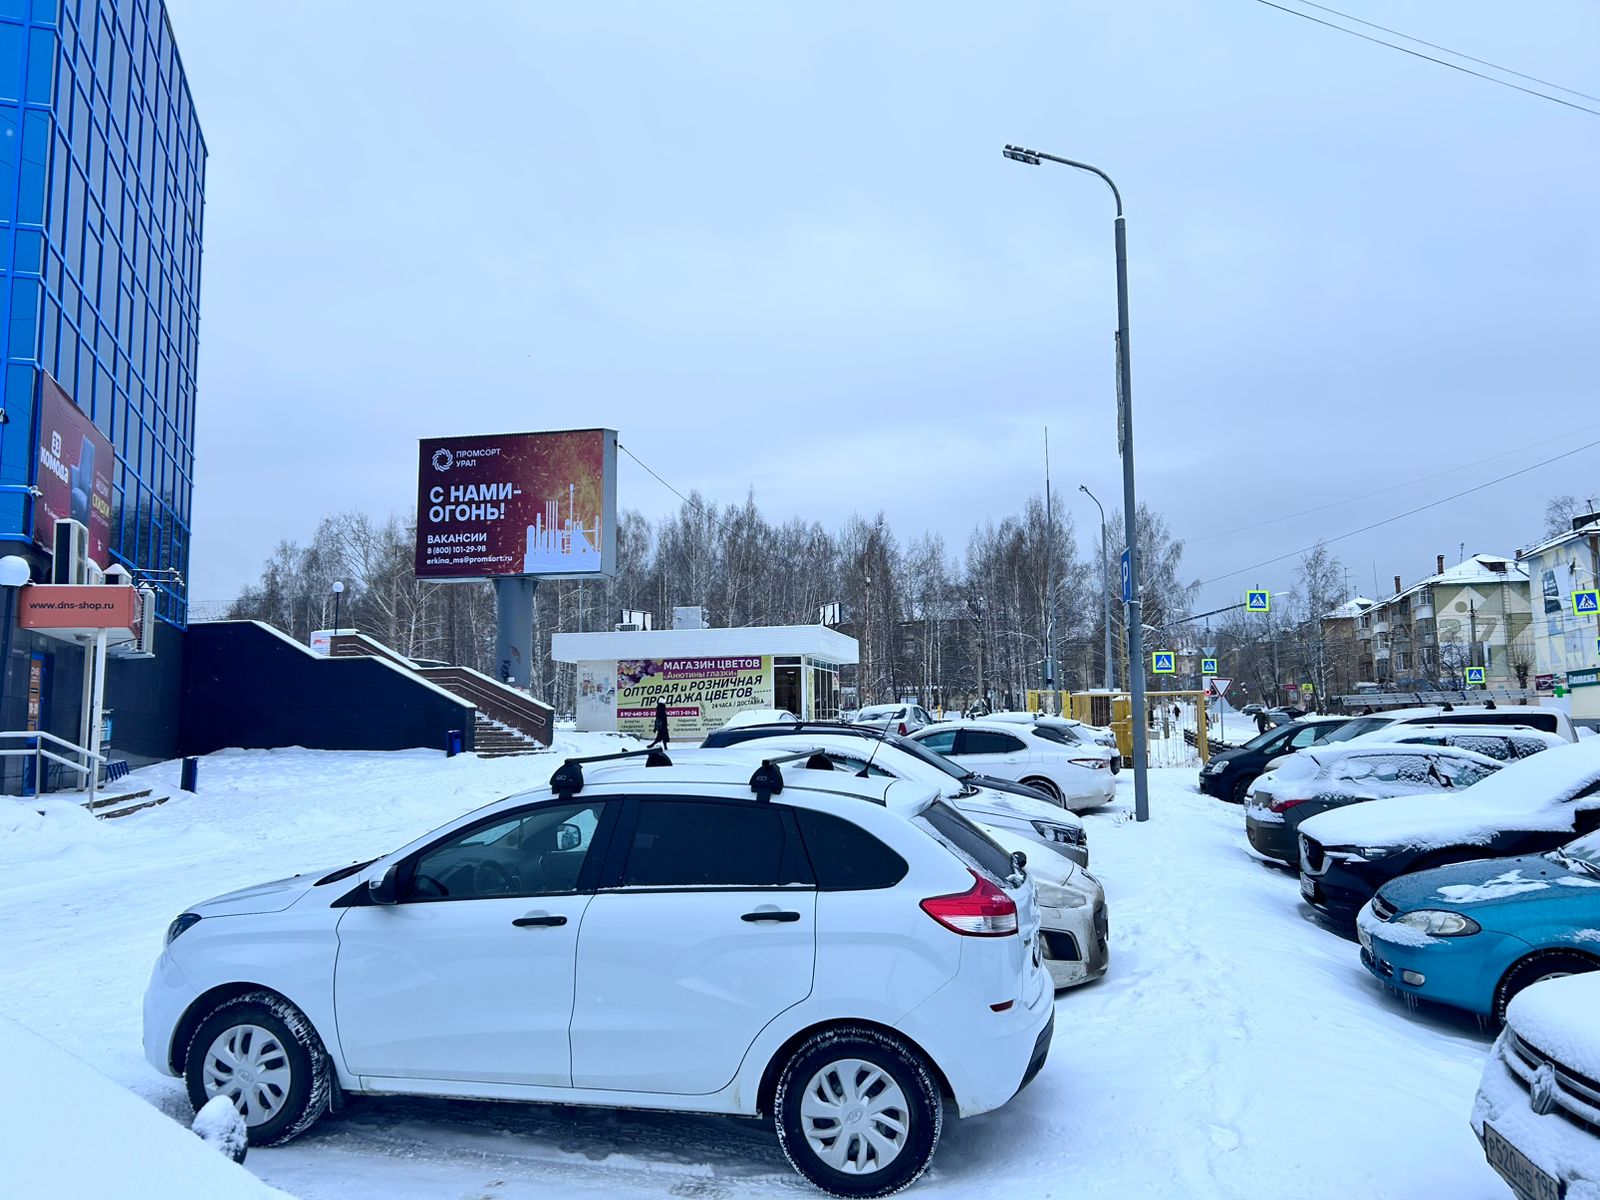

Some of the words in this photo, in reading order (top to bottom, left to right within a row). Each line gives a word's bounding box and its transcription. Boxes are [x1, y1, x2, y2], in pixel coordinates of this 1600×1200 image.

[456, 448, 501, 458] ПРОМСОРТ
[429, 486, 444, 503] С
[429, 503, 505, 522] ОГОНЬ!
[427, 533, 487, 544] ВАКАНСИИ
[433, 546, 452, 555] (800)
[453, 545, 486, 553] 101-29-98
[427, 555, 513, 564] erkina_ms@promsort.ru
[1123, 561, 1129, 595] P
[30, 601, 114, 610] www.dns-shop.ru
[663, 660, 715, 670] МАГАЗИН
[717, 659, 760, 670] ЦВЕТОВ
[623, 683, 679, 697] ОПТОВАЯ
[689, 675, 762, 691] РОЗНИЧНАЯ
[704, 687, 753, 703] ЦВЕТОВ
[737, 699, 764, 707] ДОСТАВКА
